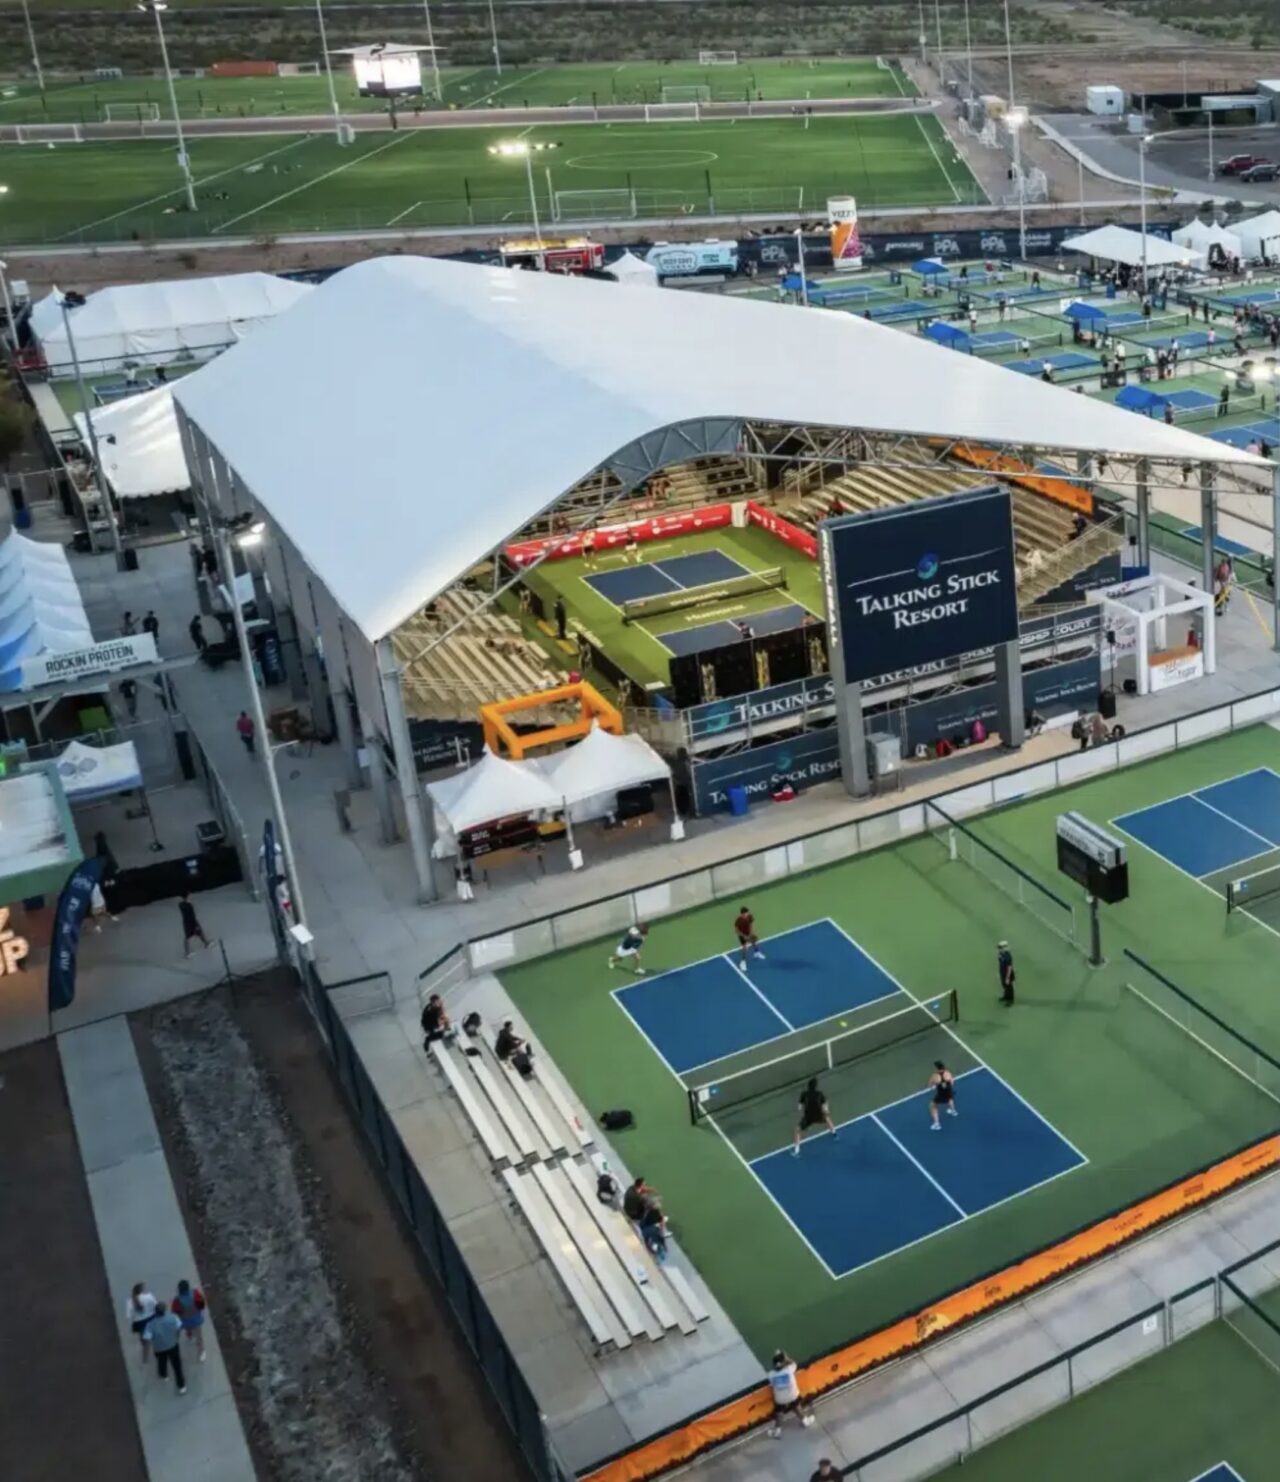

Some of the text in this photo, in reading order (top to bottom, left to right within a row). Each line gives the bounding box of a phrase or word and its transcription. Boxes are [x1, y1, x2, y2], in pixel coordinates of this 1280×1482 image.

[856, 570, 1001, 616] TALKING STICK
[893, 599, 969, 630] RESORT
[88, 645, 134, 664] PROTEIN
[735, 690, 818, 721] TALKING
[1053, 618, 1093, 637] COURT
[709, 780, 768, 805] TAING
